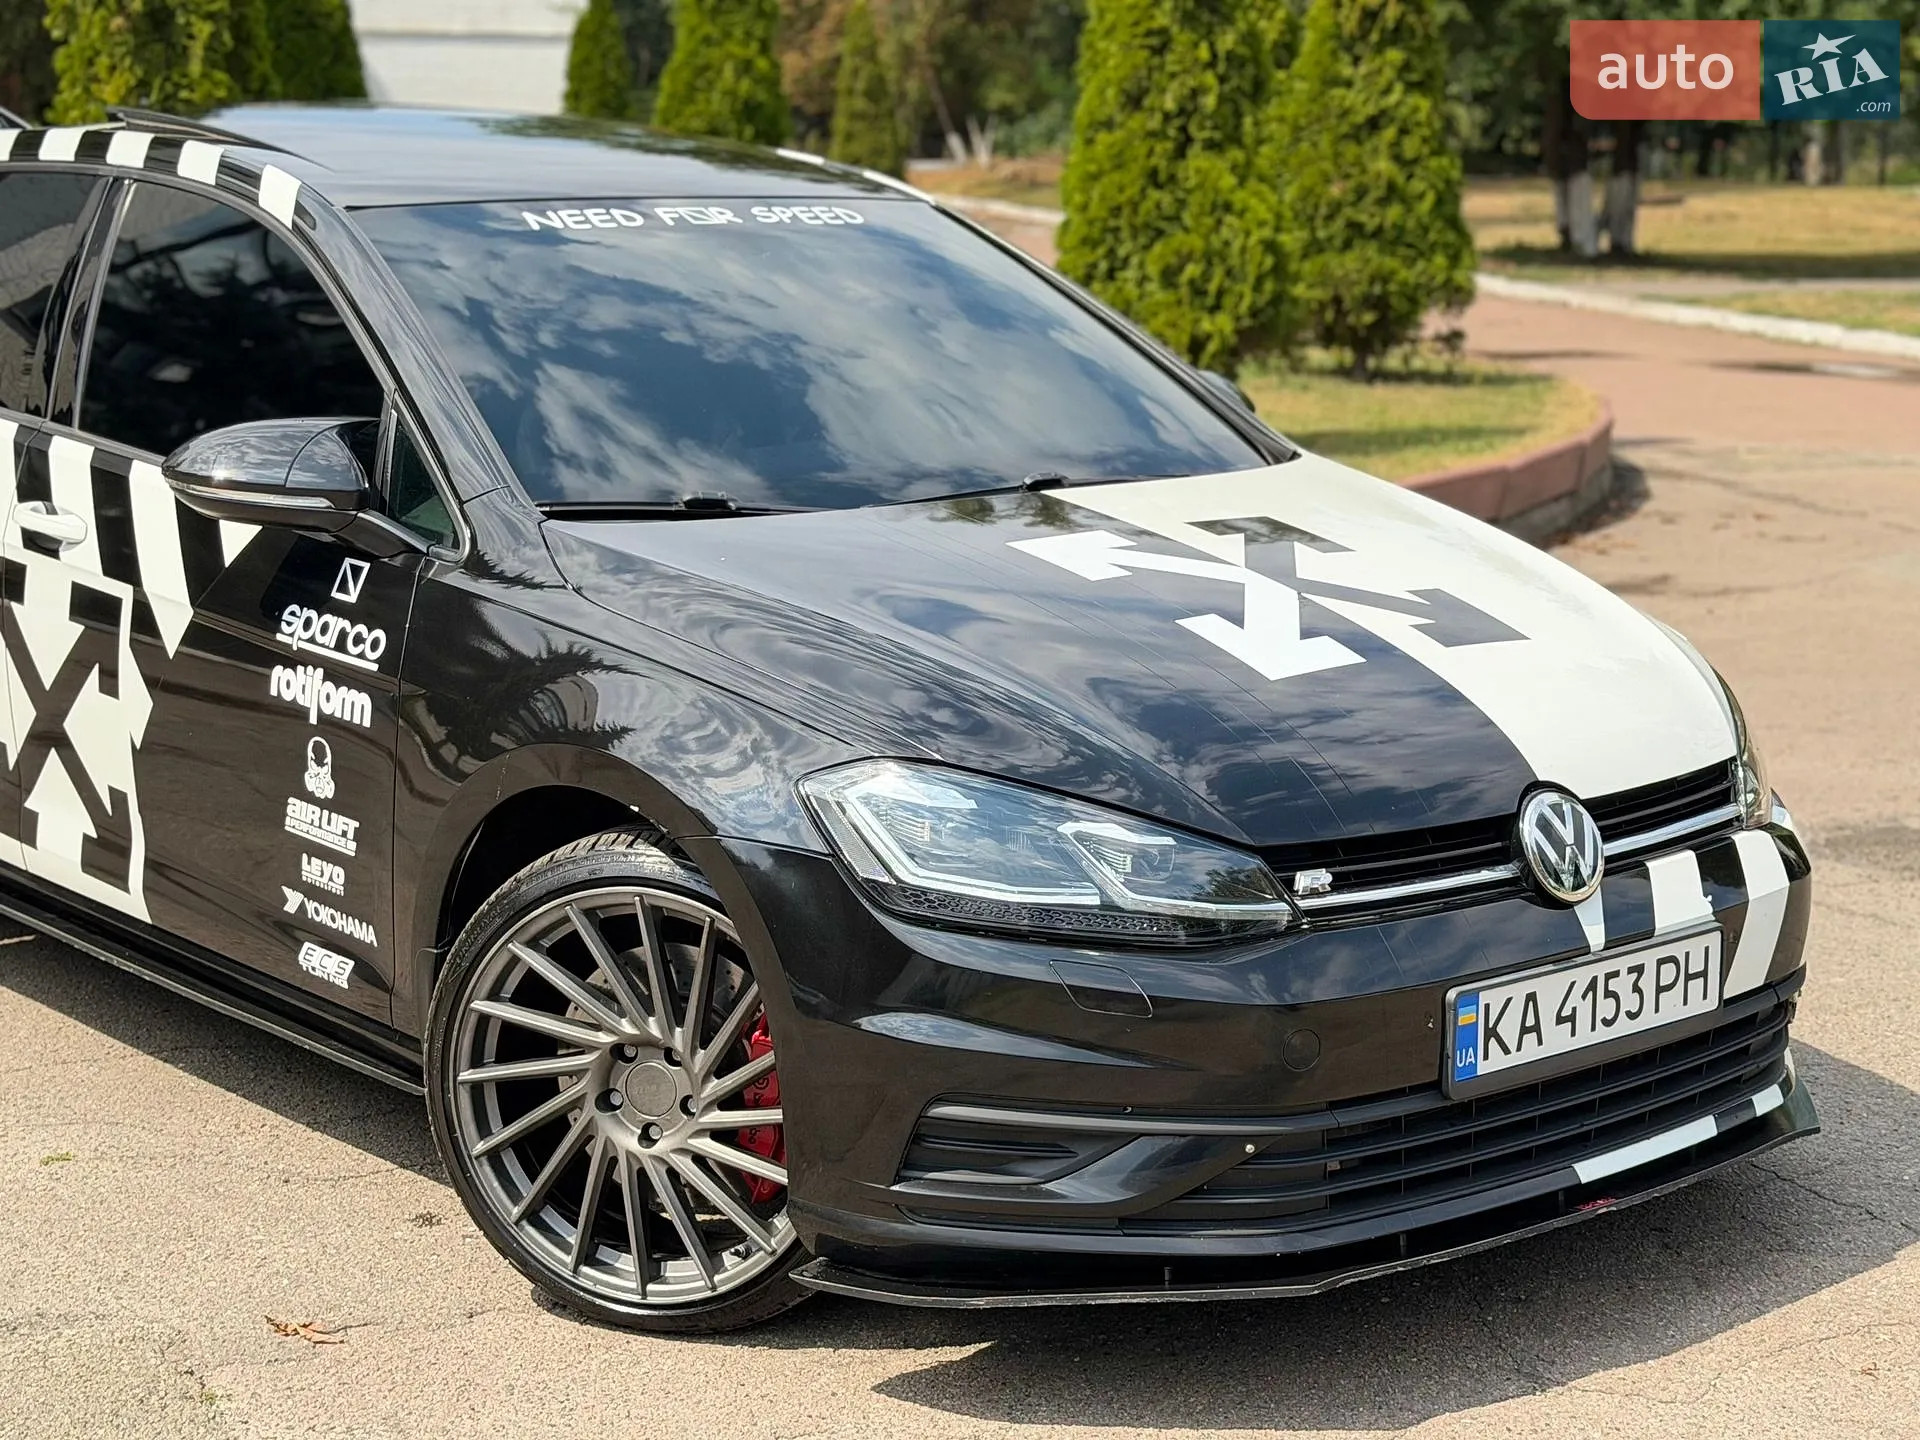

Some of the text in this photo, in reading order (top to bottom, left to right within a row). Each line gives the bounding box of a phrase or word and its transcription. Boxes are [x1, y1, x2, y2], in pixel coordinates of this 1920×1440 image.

[522, 207, 645, 231] NEED
[751, 206, 865, 225] SPEED
[281, 604, 387, 661] sparco
[270, 665, 373, 728] rotiform
[304, 897, 378, 948] YOKOHAMA
[302, 946, 350, 976] ECS
[1482, 945, 1711, 1062] KA 4153 PH
[1456, 1046, 1476, 1068] UA
